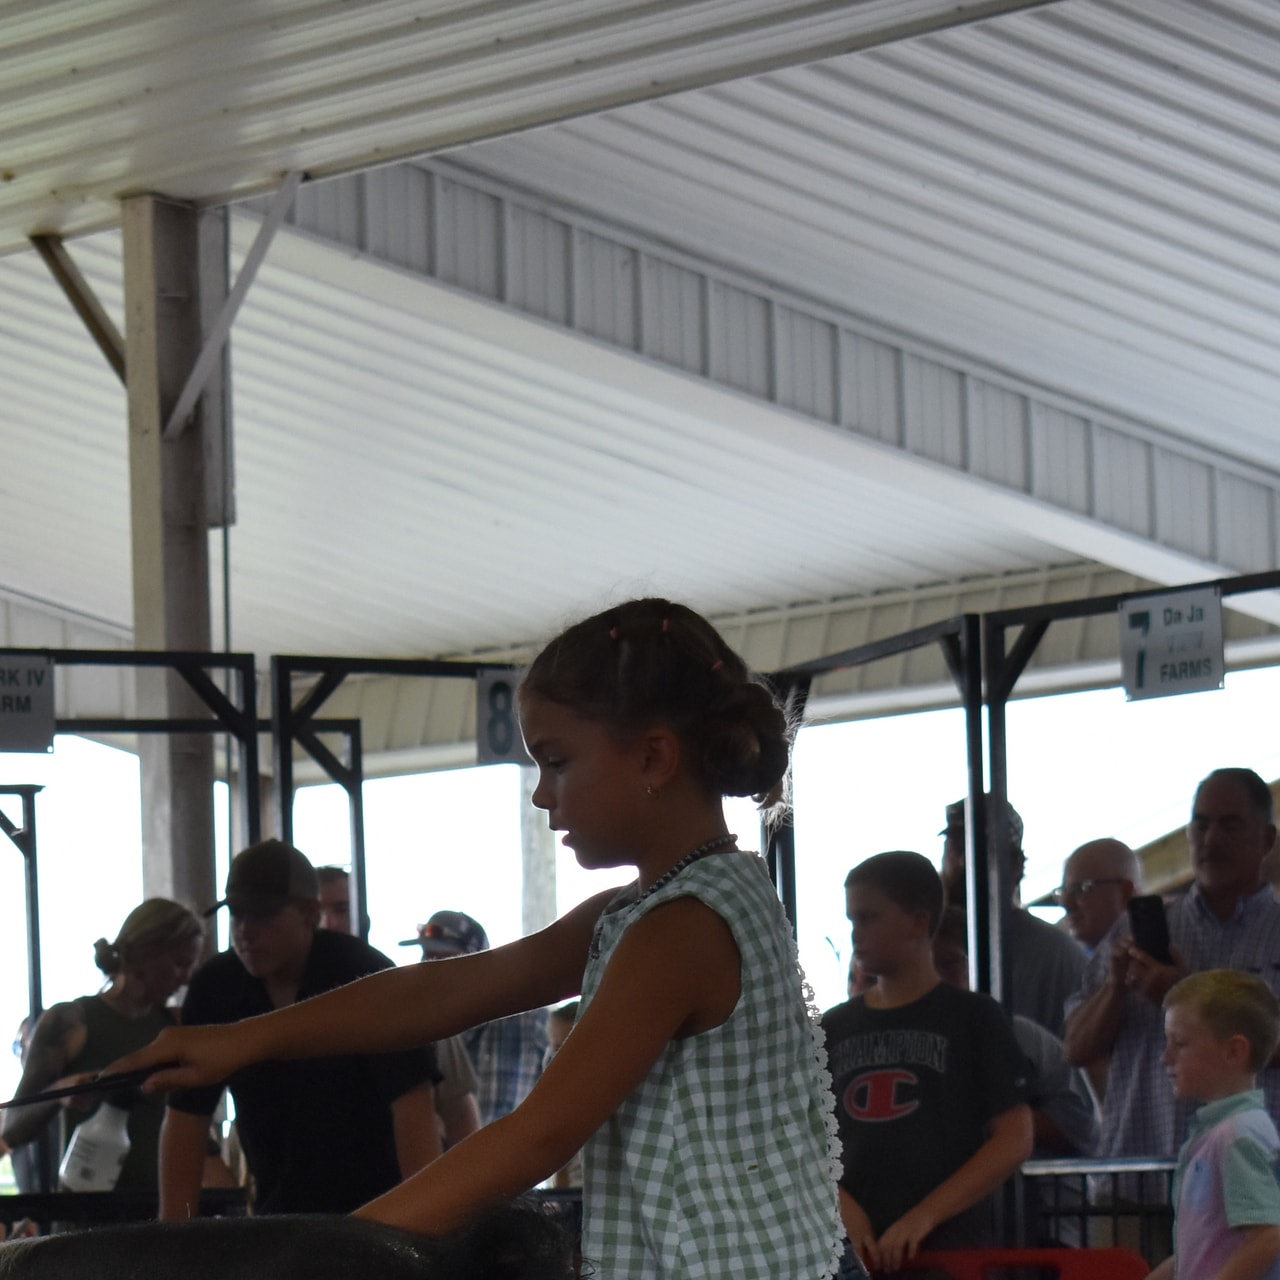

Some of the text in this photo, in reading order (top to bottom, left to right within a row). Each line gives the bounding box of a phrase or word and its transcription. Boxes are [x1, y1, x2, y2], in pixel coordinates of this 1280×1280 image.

[1163, 604, 1205, 627] Da Ja
[1128, 609, 1151, 690] 7
[26, 668, 47, 688] IV
[1160, 658, 1214, 683] FARMS
[486, 681, 514, 757] 8
